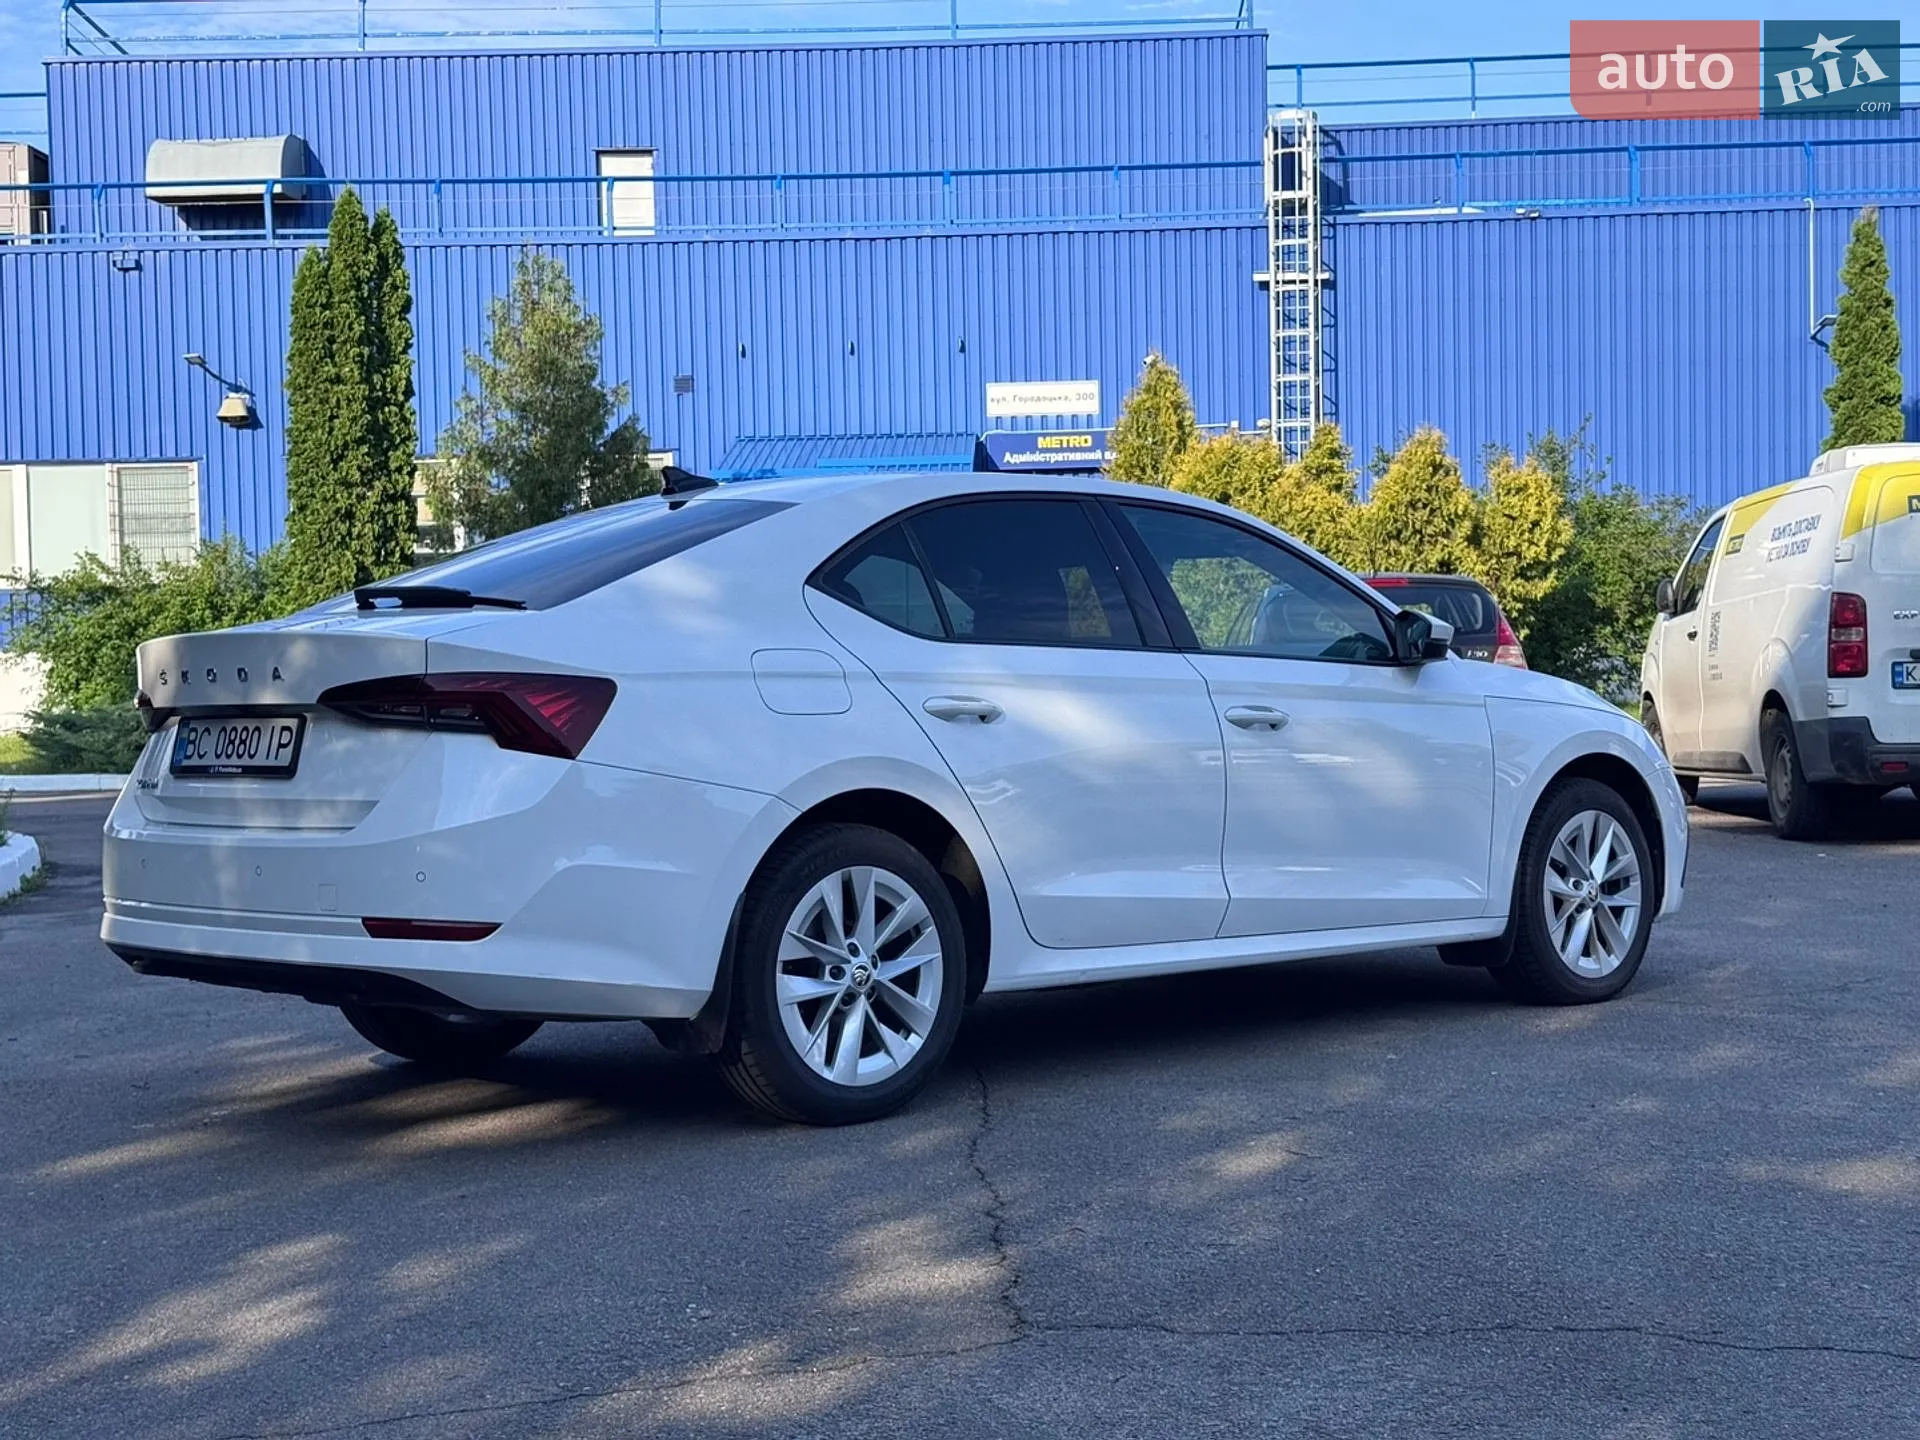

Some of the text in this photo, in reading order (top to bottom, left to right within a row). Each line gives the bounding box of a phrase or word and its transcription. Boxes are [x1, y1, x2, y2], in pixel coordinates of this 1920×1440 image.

[1075, 391, 1096, 401] 300
[1037, 434, 1093, 449] METRO
[184, 725, 293, 760] BC 0880 IP
